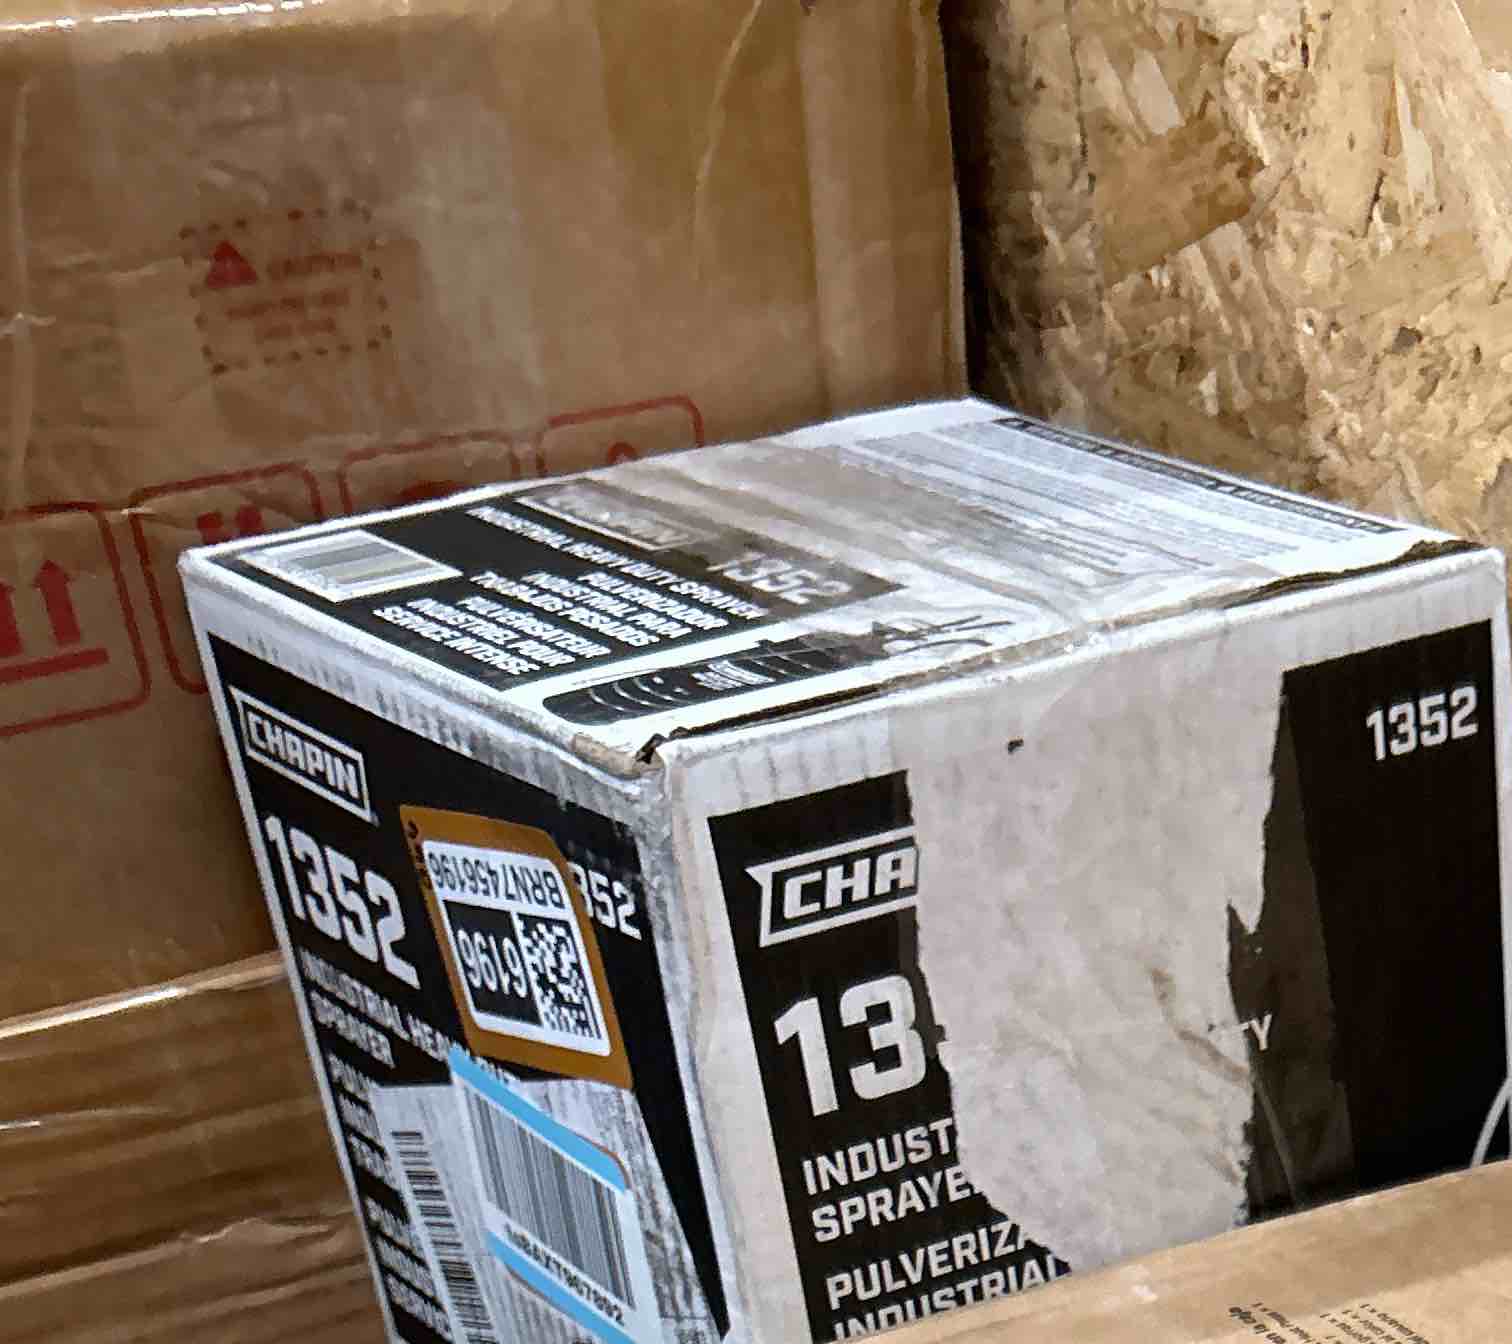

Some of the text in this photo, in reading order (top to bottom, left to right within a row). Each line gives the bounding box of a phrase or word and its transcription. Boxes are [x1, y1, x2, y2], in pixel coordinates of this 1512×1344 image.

[466, 505, 573, 548] INDUSTRIAL
[562, 542, 634, 567] HEAVY
[619, 562, 684, 585] DUTY
[669, 581, 768, 619] SPRAYER
[707, 552, 852, 605] 1352
[469, 570, 659, 646] TRABAJOS PESADOS
[522, 572, 691, 638] INDUSTRIAL PARA
[577, 572, 728, 629] PULVERIZADOR
[373, 605, 540, 674] SERVICE INTENSE
[506, 639, 575, 666] POUR
[247, 712, 361, 799] CHAPIN
[1366, 686, 1479, 761] 1352
[264, 814, 422, 990] 1352
[428, 850, 566, 911] BRN7456196
[457, 928, 529, 999] 6196
[774, 974, 950, 1117] 13
[811, 1163, 982, 1244] SPRAYE
[1265, 1332, 1286, 1344] en
